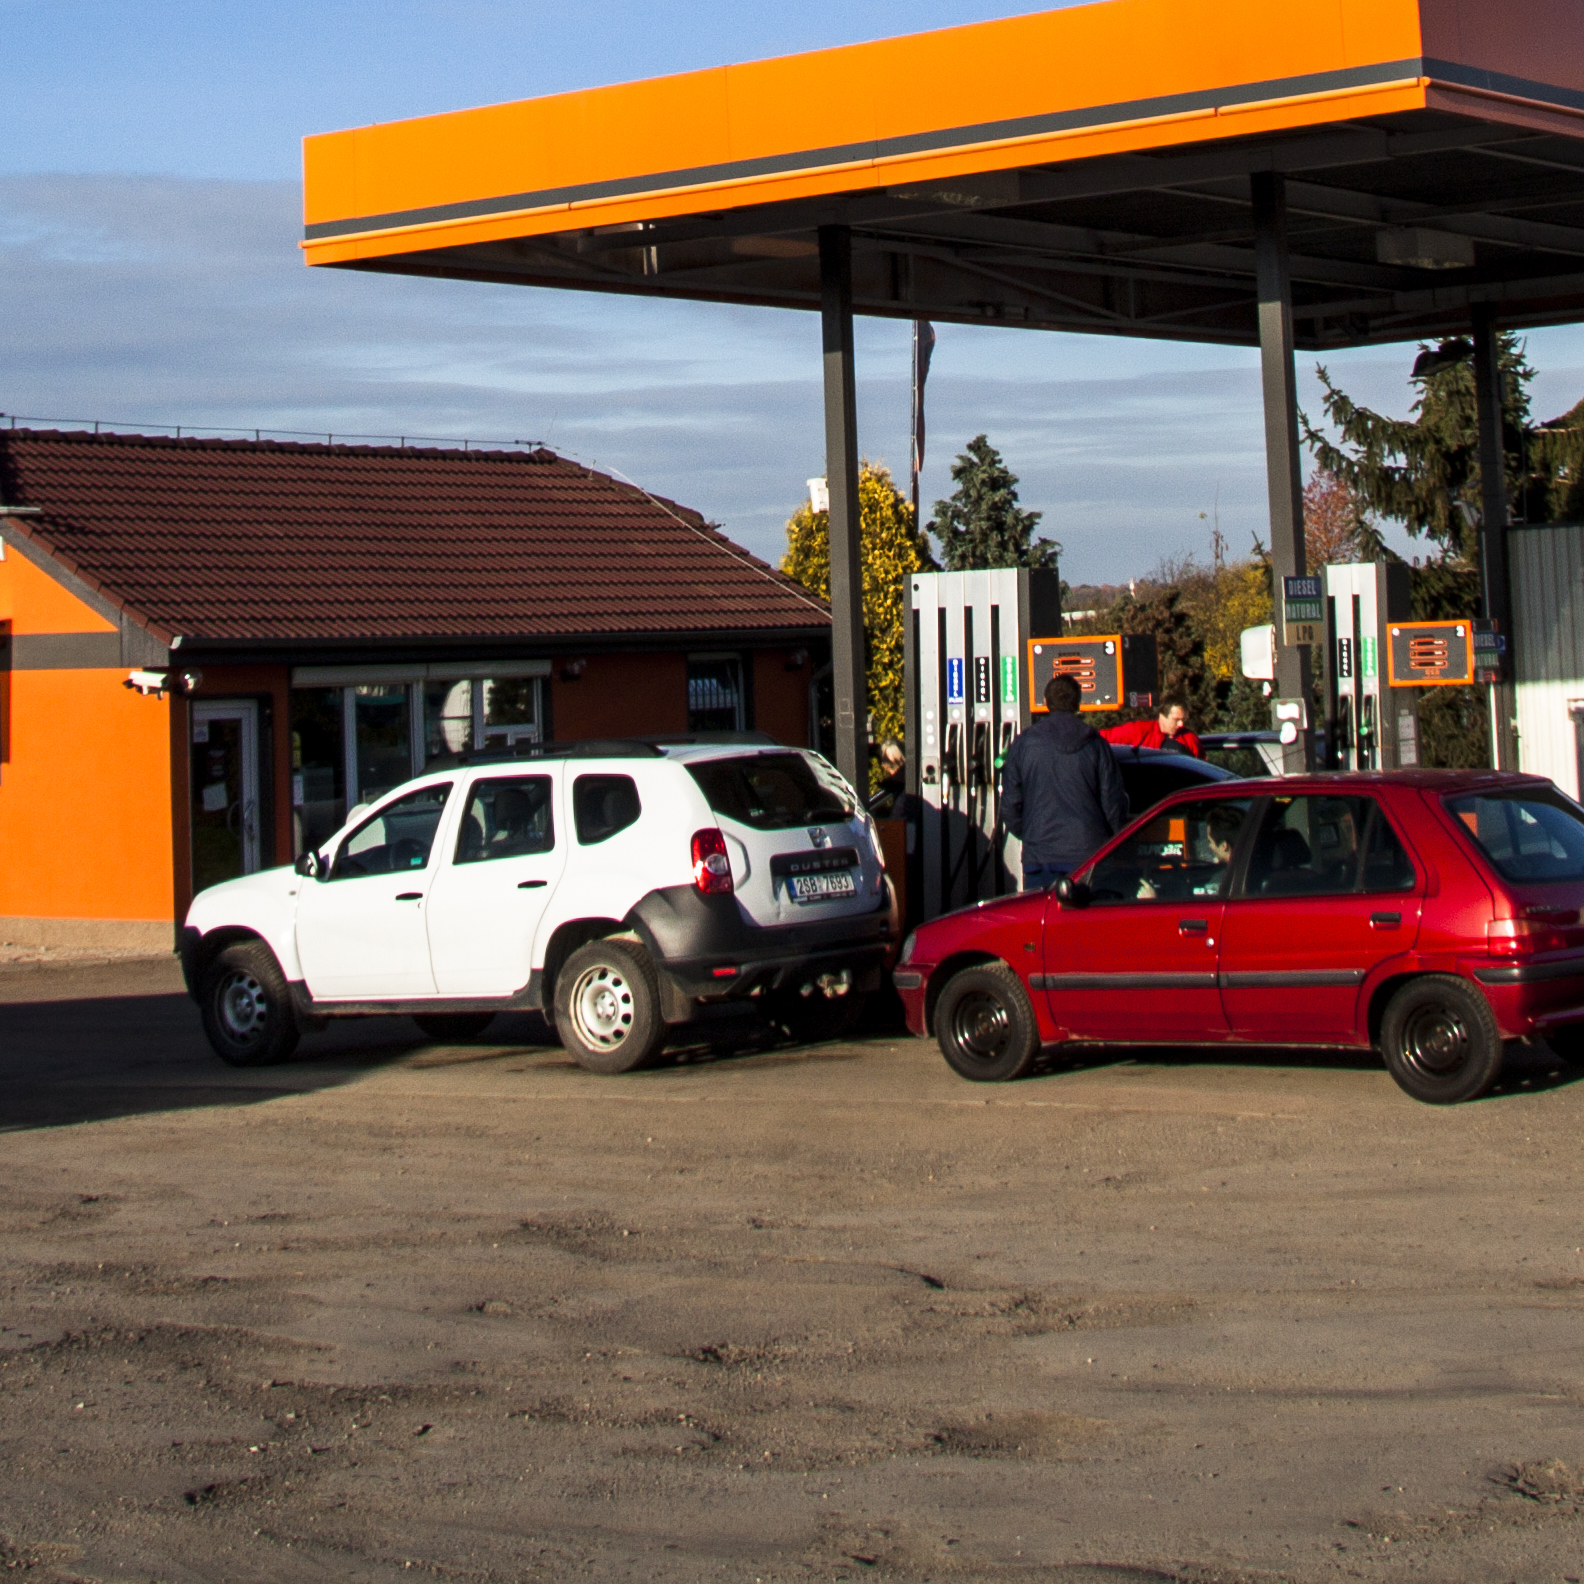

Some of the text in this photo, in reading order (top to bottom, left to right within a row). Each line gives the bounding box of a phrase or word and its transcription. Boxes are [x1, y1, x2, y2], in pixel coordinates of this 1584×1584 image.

[1288, 579, 1316, 595] DIESEL
[1286, 603, 1320, 618] NATURAL
[1297, 624, 1314, 641] LPG
[1456, 625, 1465, 636] 2
[1105, 641, 1114, 655] 3
[790, 858, 849, 871] DUSTER
[797, 873, 849, 895] 2SB 7693
